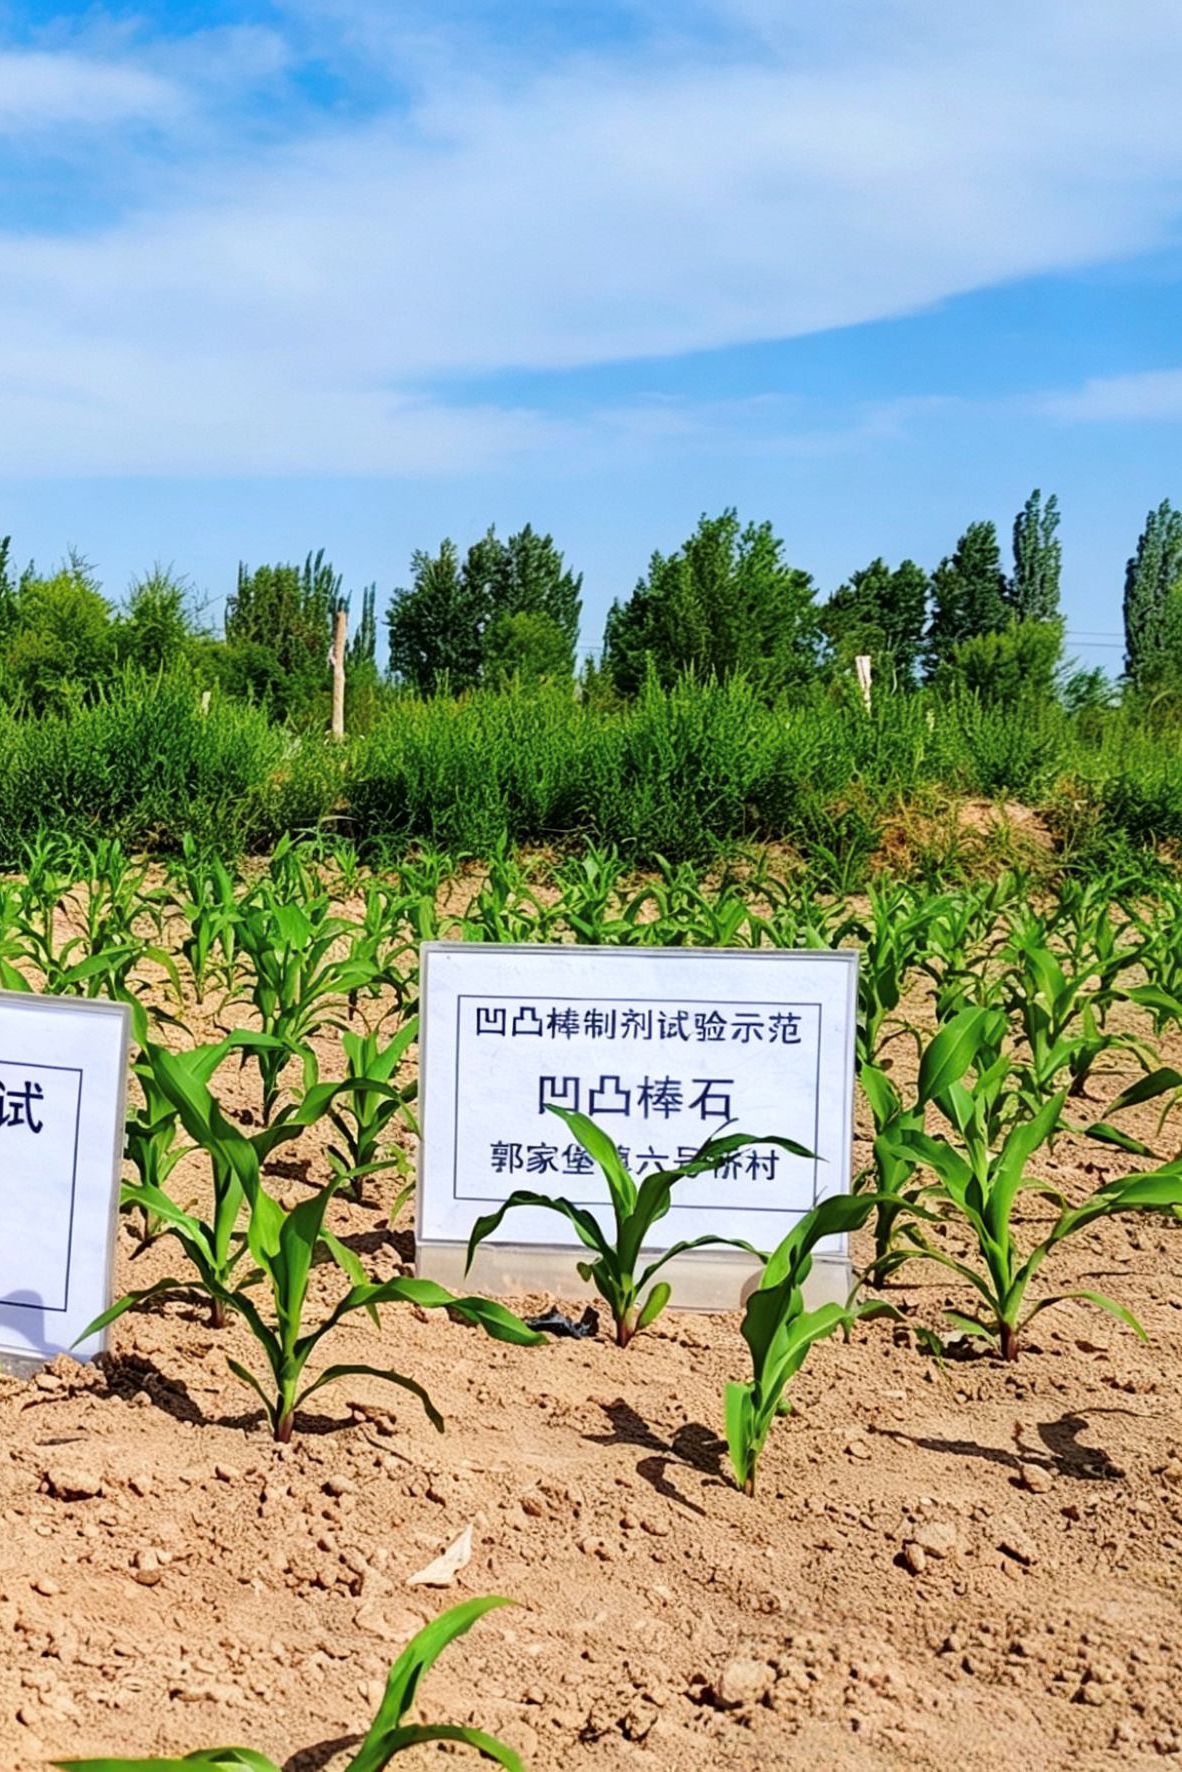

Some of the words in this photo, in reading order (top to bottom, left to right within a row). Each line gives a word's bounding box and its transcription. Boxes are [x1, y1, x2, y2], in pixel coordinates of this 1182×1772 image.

[475, 1006, 802, 1045] 凹凸棒制剂试验示范
[538, 1075, 735, 1121] 凹凸棒石
